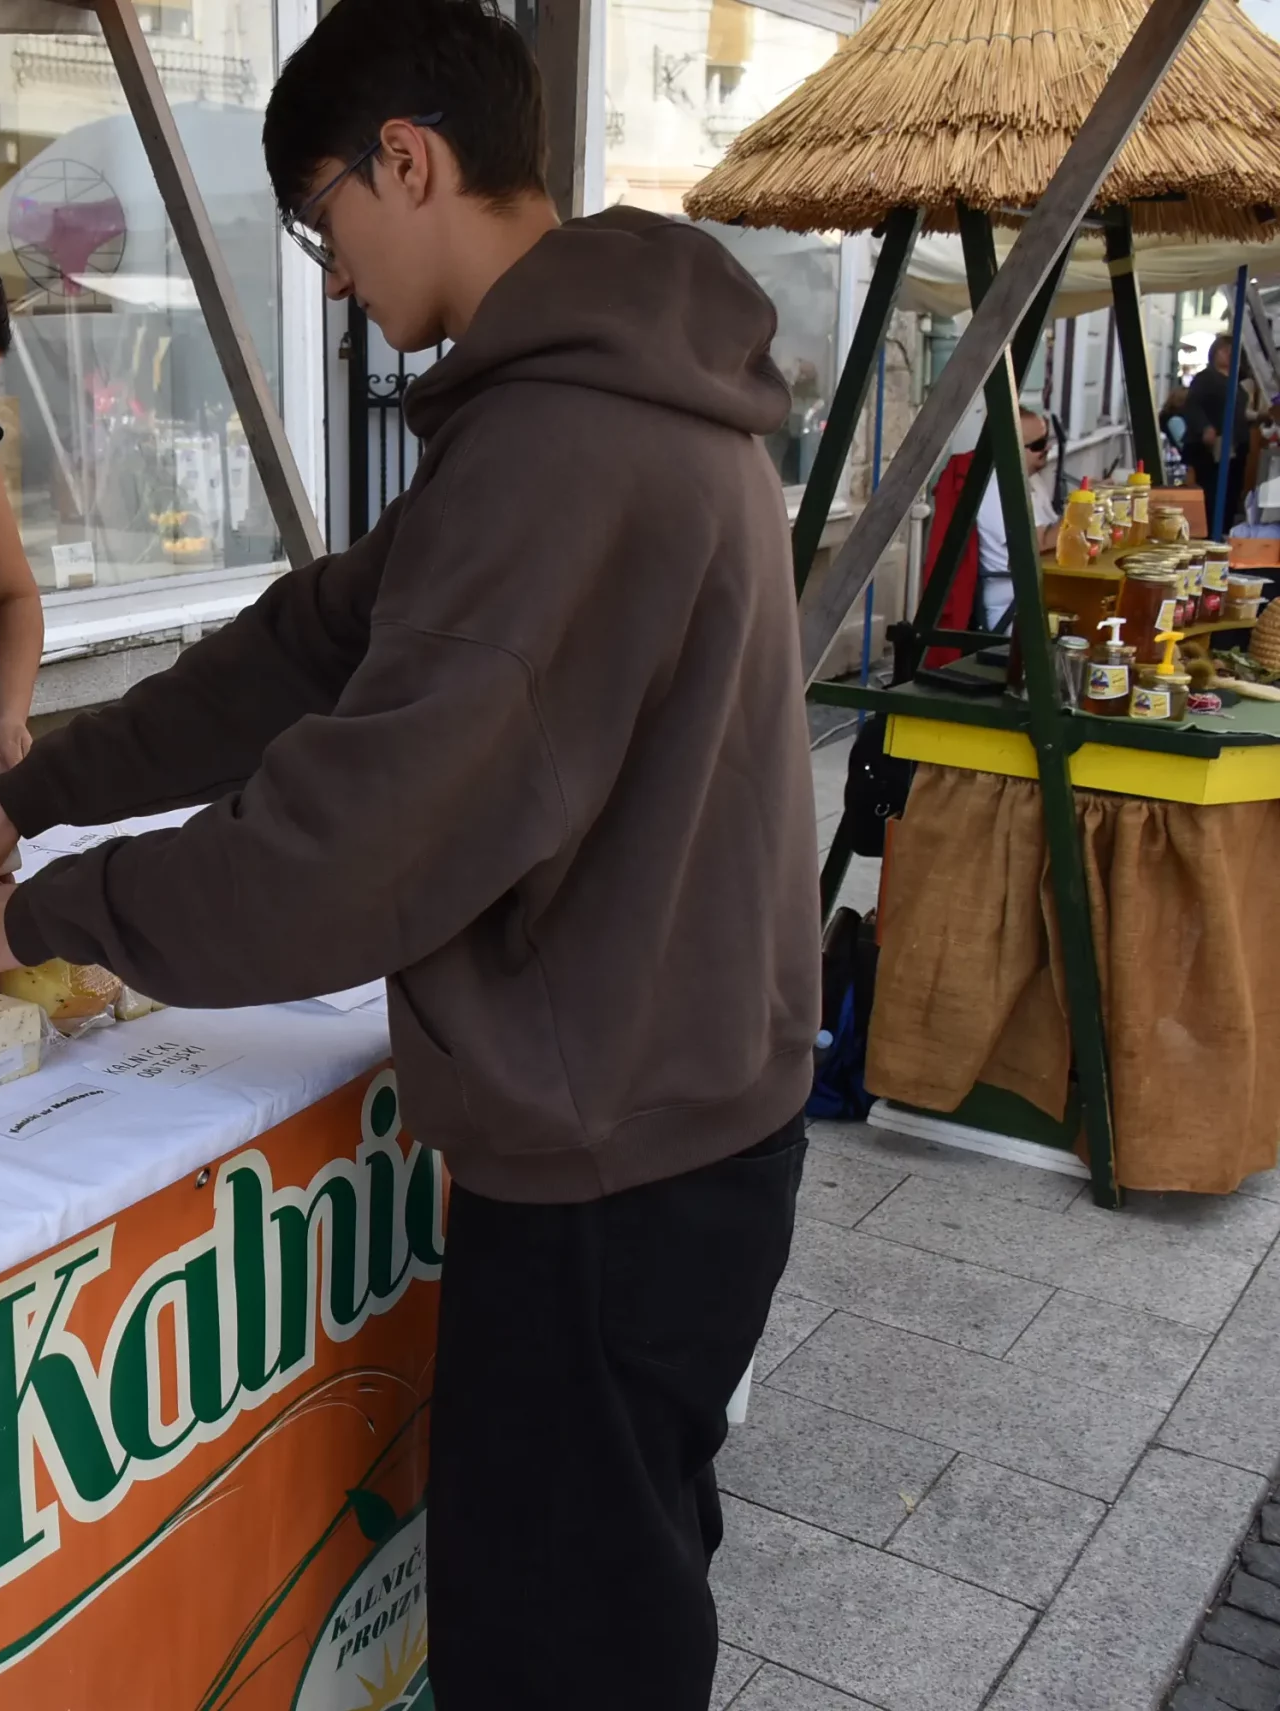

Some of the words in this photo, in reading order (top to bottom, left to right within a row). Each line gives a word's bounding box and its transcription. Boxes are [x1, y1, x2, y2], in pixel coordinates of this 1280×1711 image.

[180, 1063, 209, 1076] SIR
[330, 1542, 427, 1644] KALNIČ
[335, 1582, 427, 1672] PROIZV
